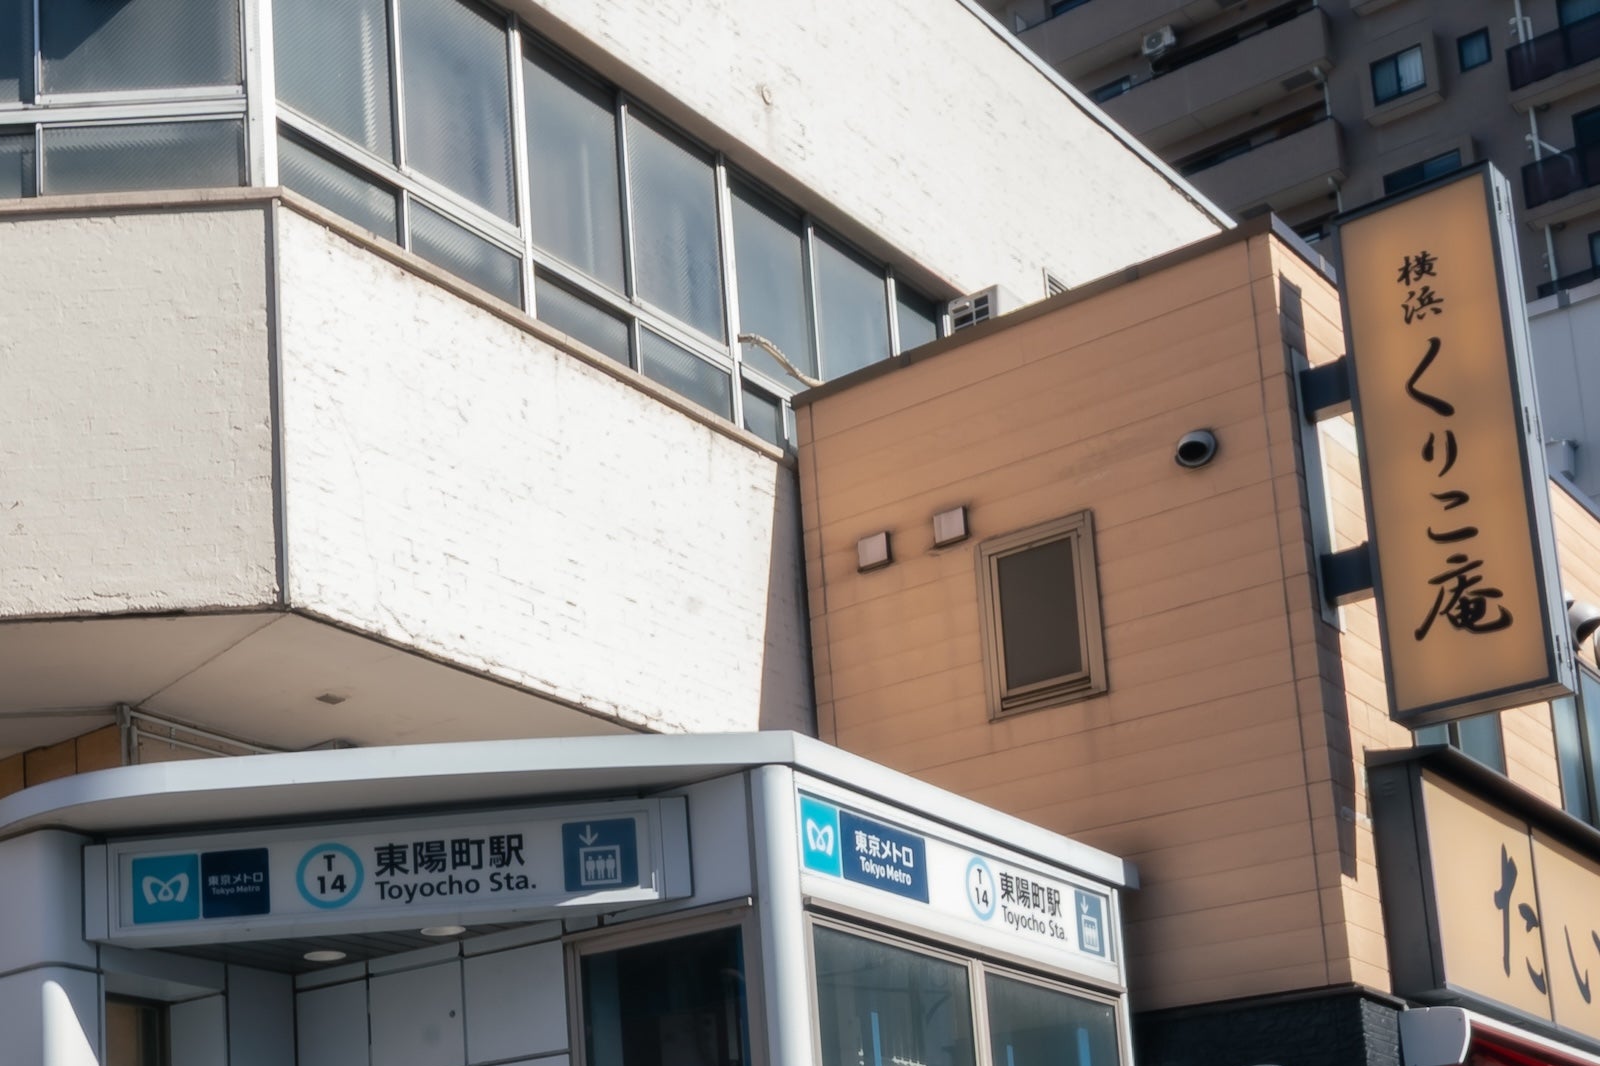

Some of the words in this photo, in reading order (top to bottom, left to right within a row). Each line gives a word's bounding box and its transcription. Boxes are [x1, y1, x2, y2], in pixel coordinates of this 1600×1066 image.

[1397, 250, 1444, 324] 横浜
[1405, 336, 1513, 641] くりこ庵
[323, 854, 336, 872] T
[374, 834, 525, 877] 東陽町駅
[854, 829, 914, 868] 東京メトロ
[207, 871, 264, 887] 東京メトロ
[316, 874, 347, 895] 14
[374, 877, 481, 904] Toyocho
[488, 871, 538, 893] Sta.
[859, 856, 886, 880] Tokyo
[886, 865, 912, 887] Metro
[976, 868, 983, 884] T
[211, 886, 236, 897] Tokyo
[238, 883, 261, 894] Metro
[975, 887, 989, 908] 14
[999, 872, 1062, 918] 東陽町駅
[1001, 905, 1045, 936] Toyocho
[1049, 917, 1068, 942] Sta.
